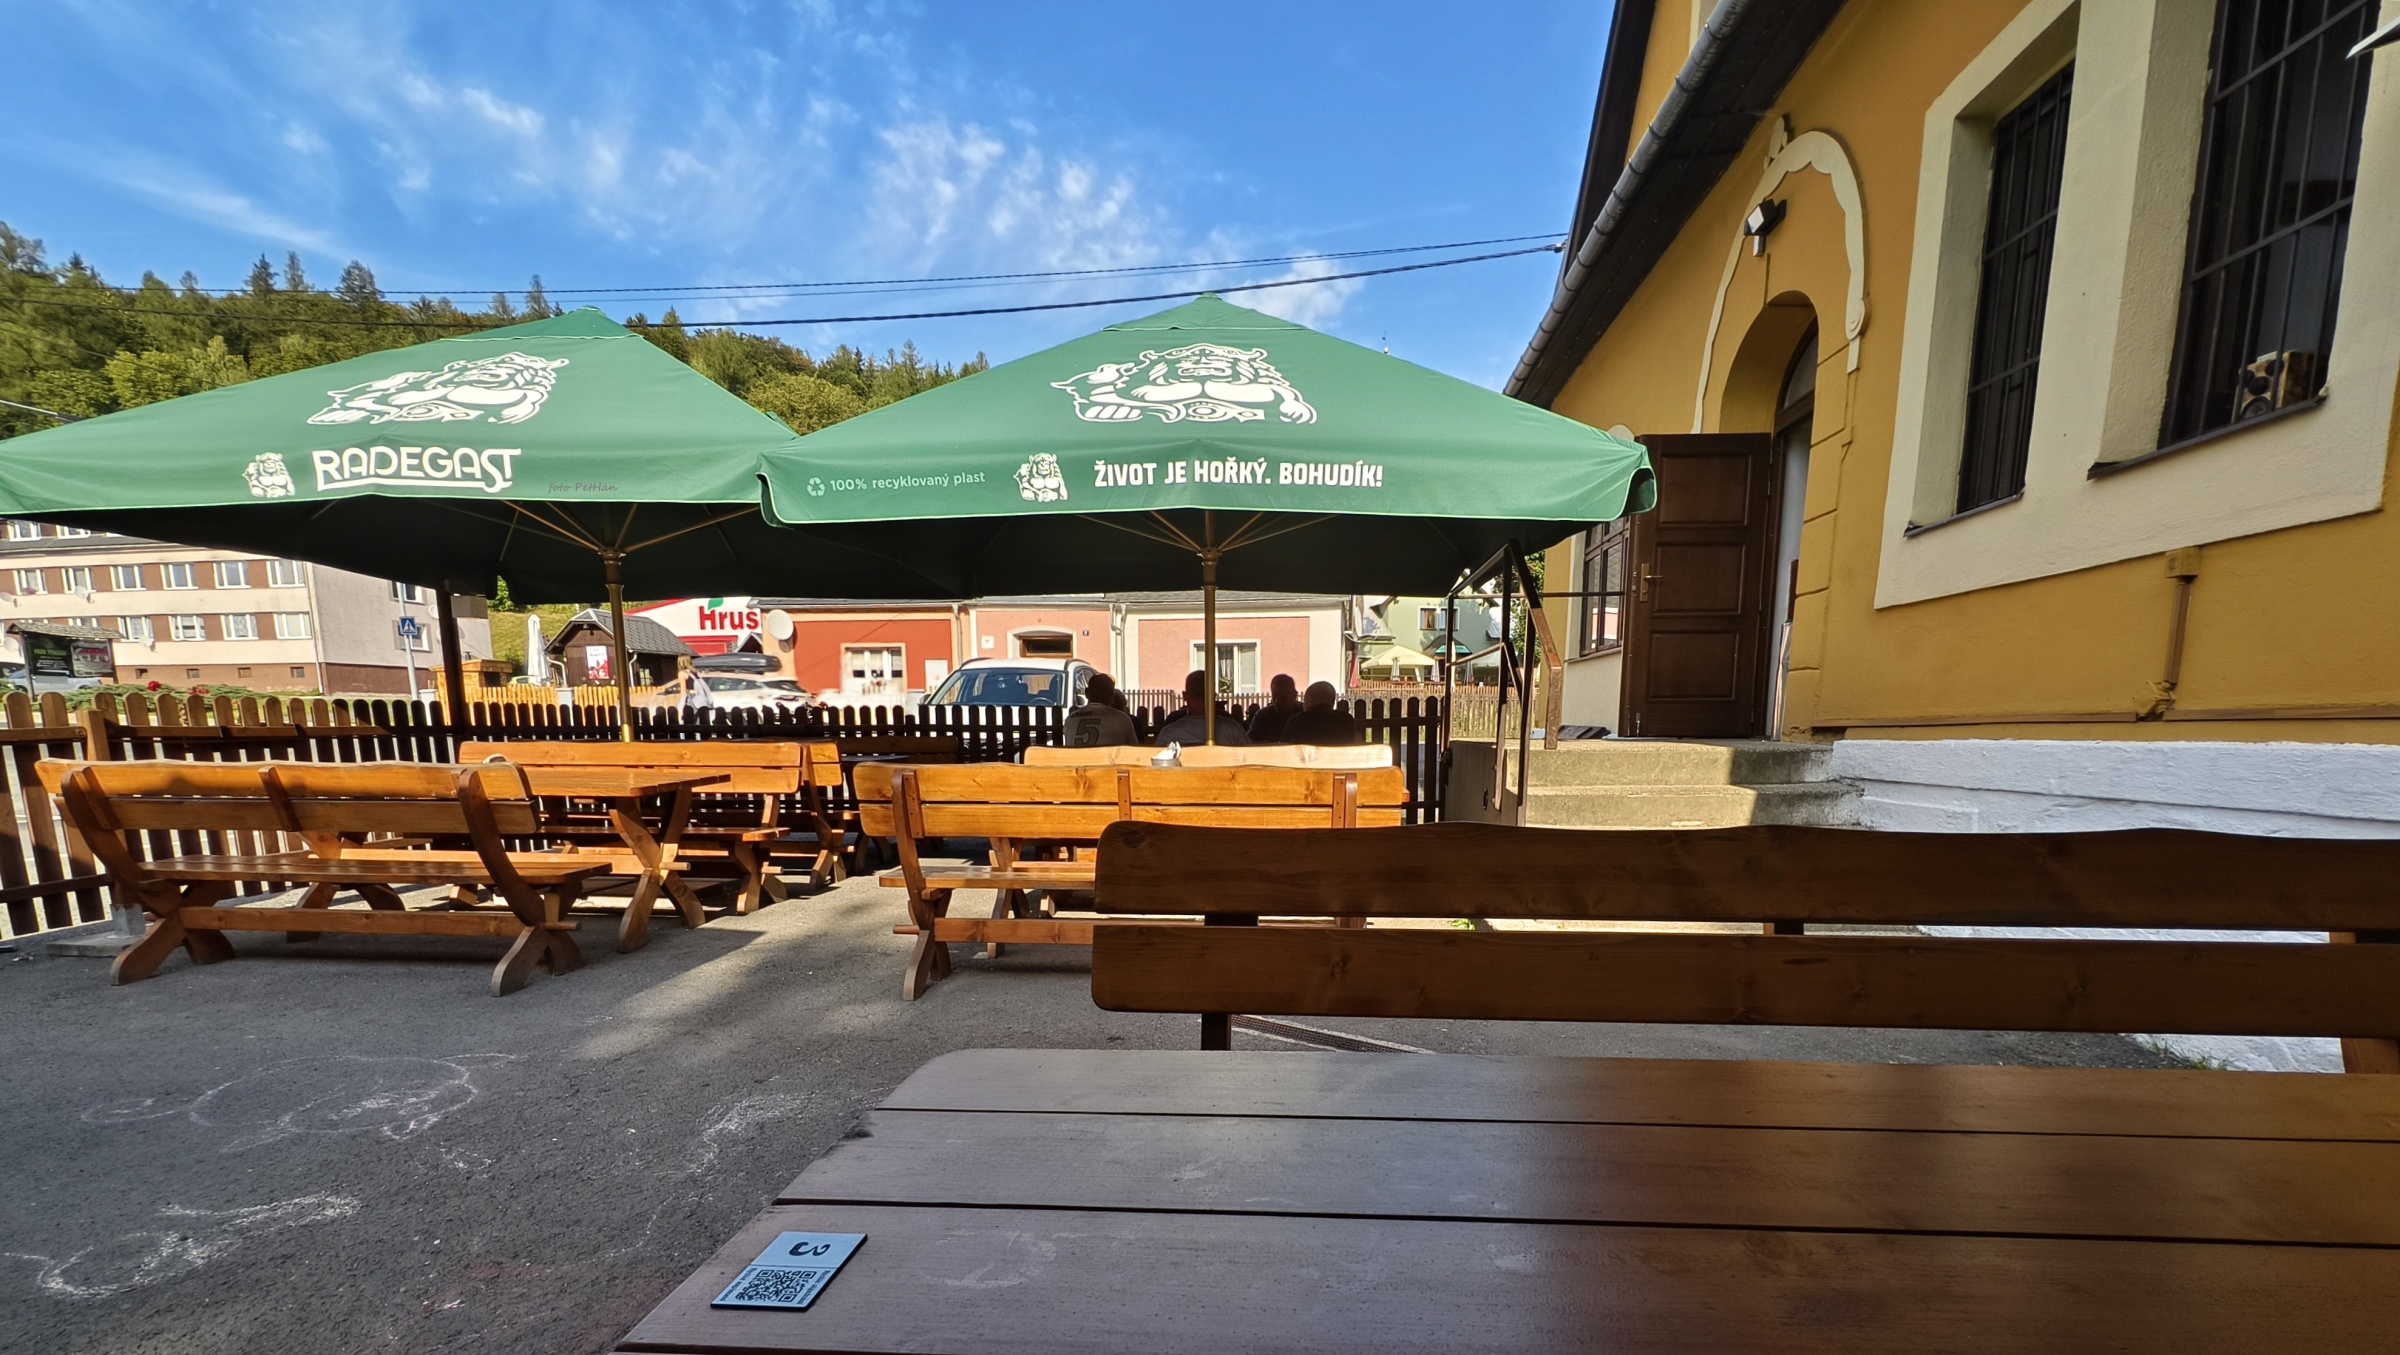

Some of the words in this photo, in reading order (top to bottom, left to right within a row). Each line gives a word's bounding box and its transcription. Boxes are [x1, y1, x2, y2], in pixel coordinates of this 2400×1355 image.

[312, 446, 521, 493] RADEGAST
[830, 478, 867, 492] 100%
[872, 473, 950, 490] recyklovaný
[953, 471, 986, 486] plast
[1094, 460, 1158, 487] ŽIVOT
[1164, 461, 1187, 484] JE
[1194, 456, 1271, 485] HOŘKÝ.
[1279, 460, 1383, 487] BOHUDÍK!
[1075, 718, 1101, 746] 5
[788, 1241, 831, 1257] 3
